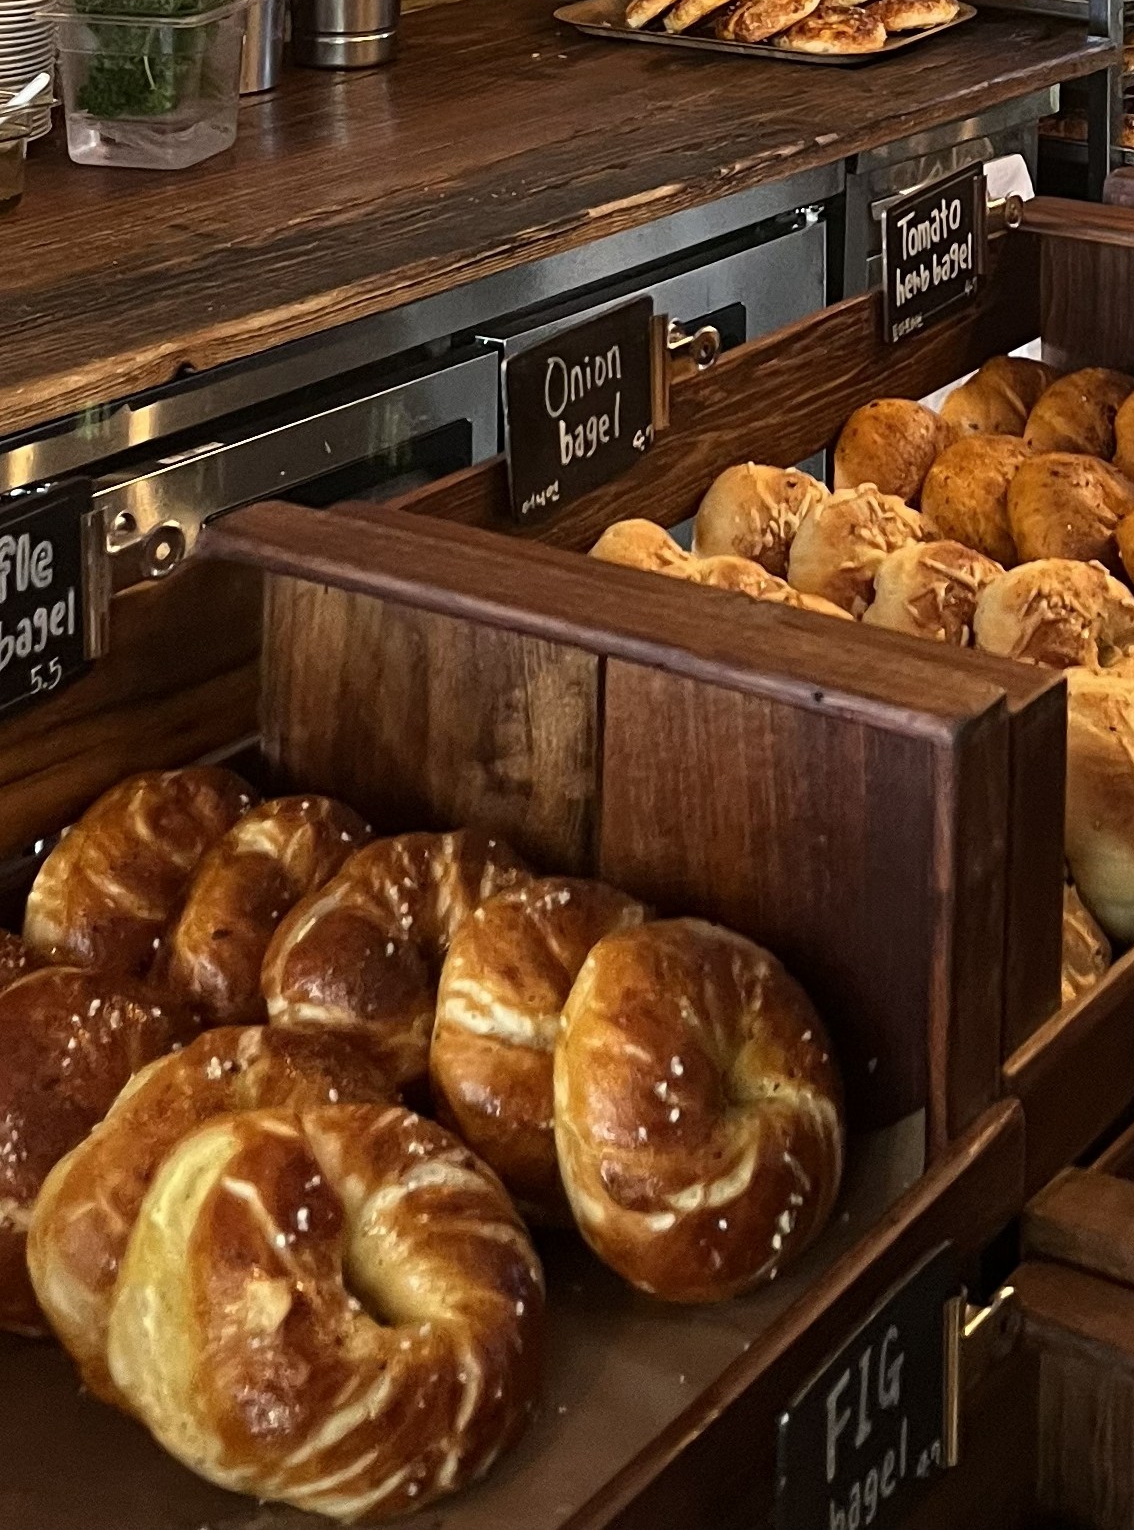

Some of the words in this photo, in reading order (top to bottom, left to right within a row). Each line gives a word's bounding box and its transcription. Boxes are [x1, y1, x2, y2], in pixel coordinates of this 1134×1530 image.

[897, 198, 961, 261] Tomato
[896, 263, 931, 308] herb
[932, 231, 972, 286] bagel
[544, 345, 622, 418] Onion
[558, 390, 621, 466] bagel
[522, 479, 560, 515] 어니언
[30, 656, 63, 695] 5.5
[825, 1323, 905, 1485] FIG
